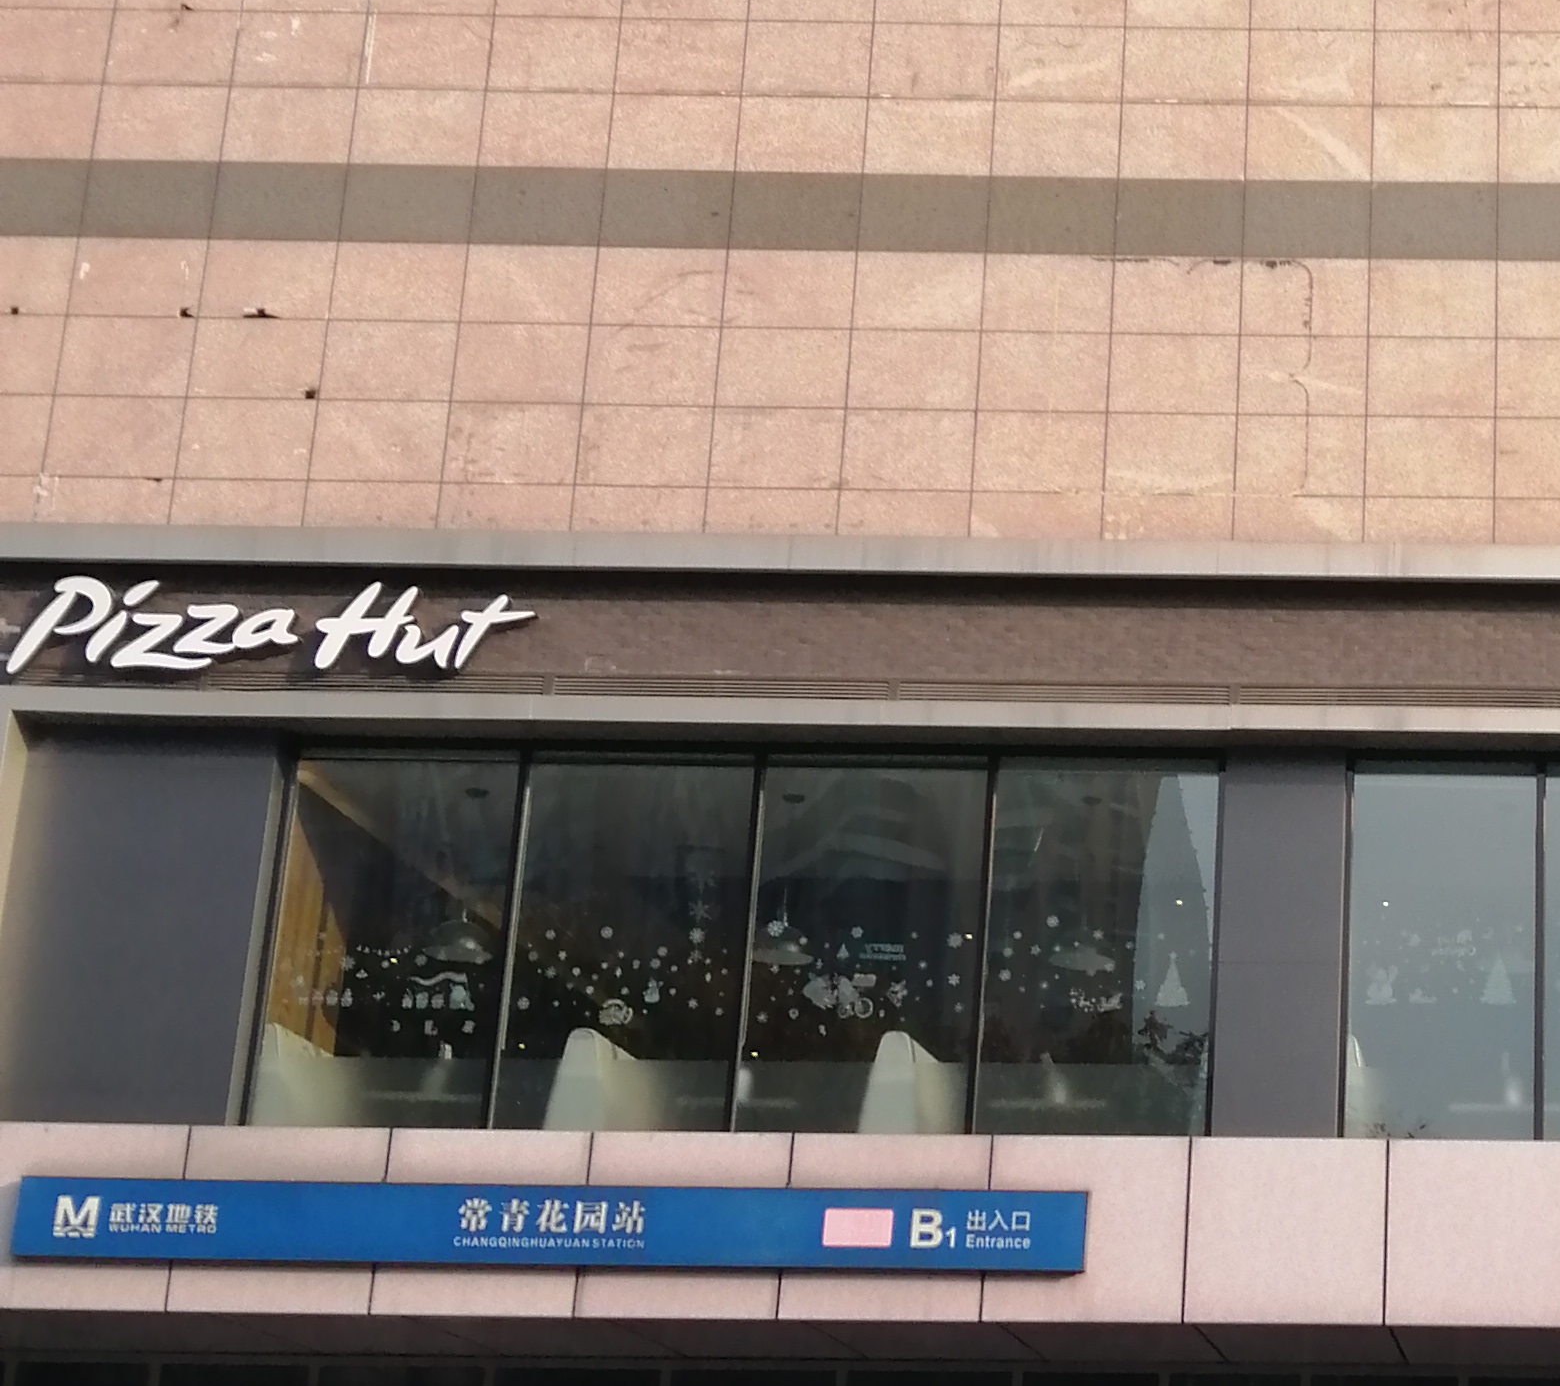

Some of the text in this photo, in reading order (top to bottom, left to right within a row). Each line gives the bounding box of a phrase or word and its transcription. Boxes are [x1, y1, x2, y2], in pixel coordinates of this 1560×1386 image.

[6, 575, 536, 675] Pizza Hut
[109, 1202, 218, 1224] 武汉地铁
[458, 1197, 646, 1234] 常青花园站
[965, 1210, 1032, 1232] 出入口
[109, 1223, 217, 1235] WUHAN METRO
[453, 1236, 646, 1250] CHANGQINGHUAYUAN STATION
[965, 1233, 1032, 1250] Entrance
